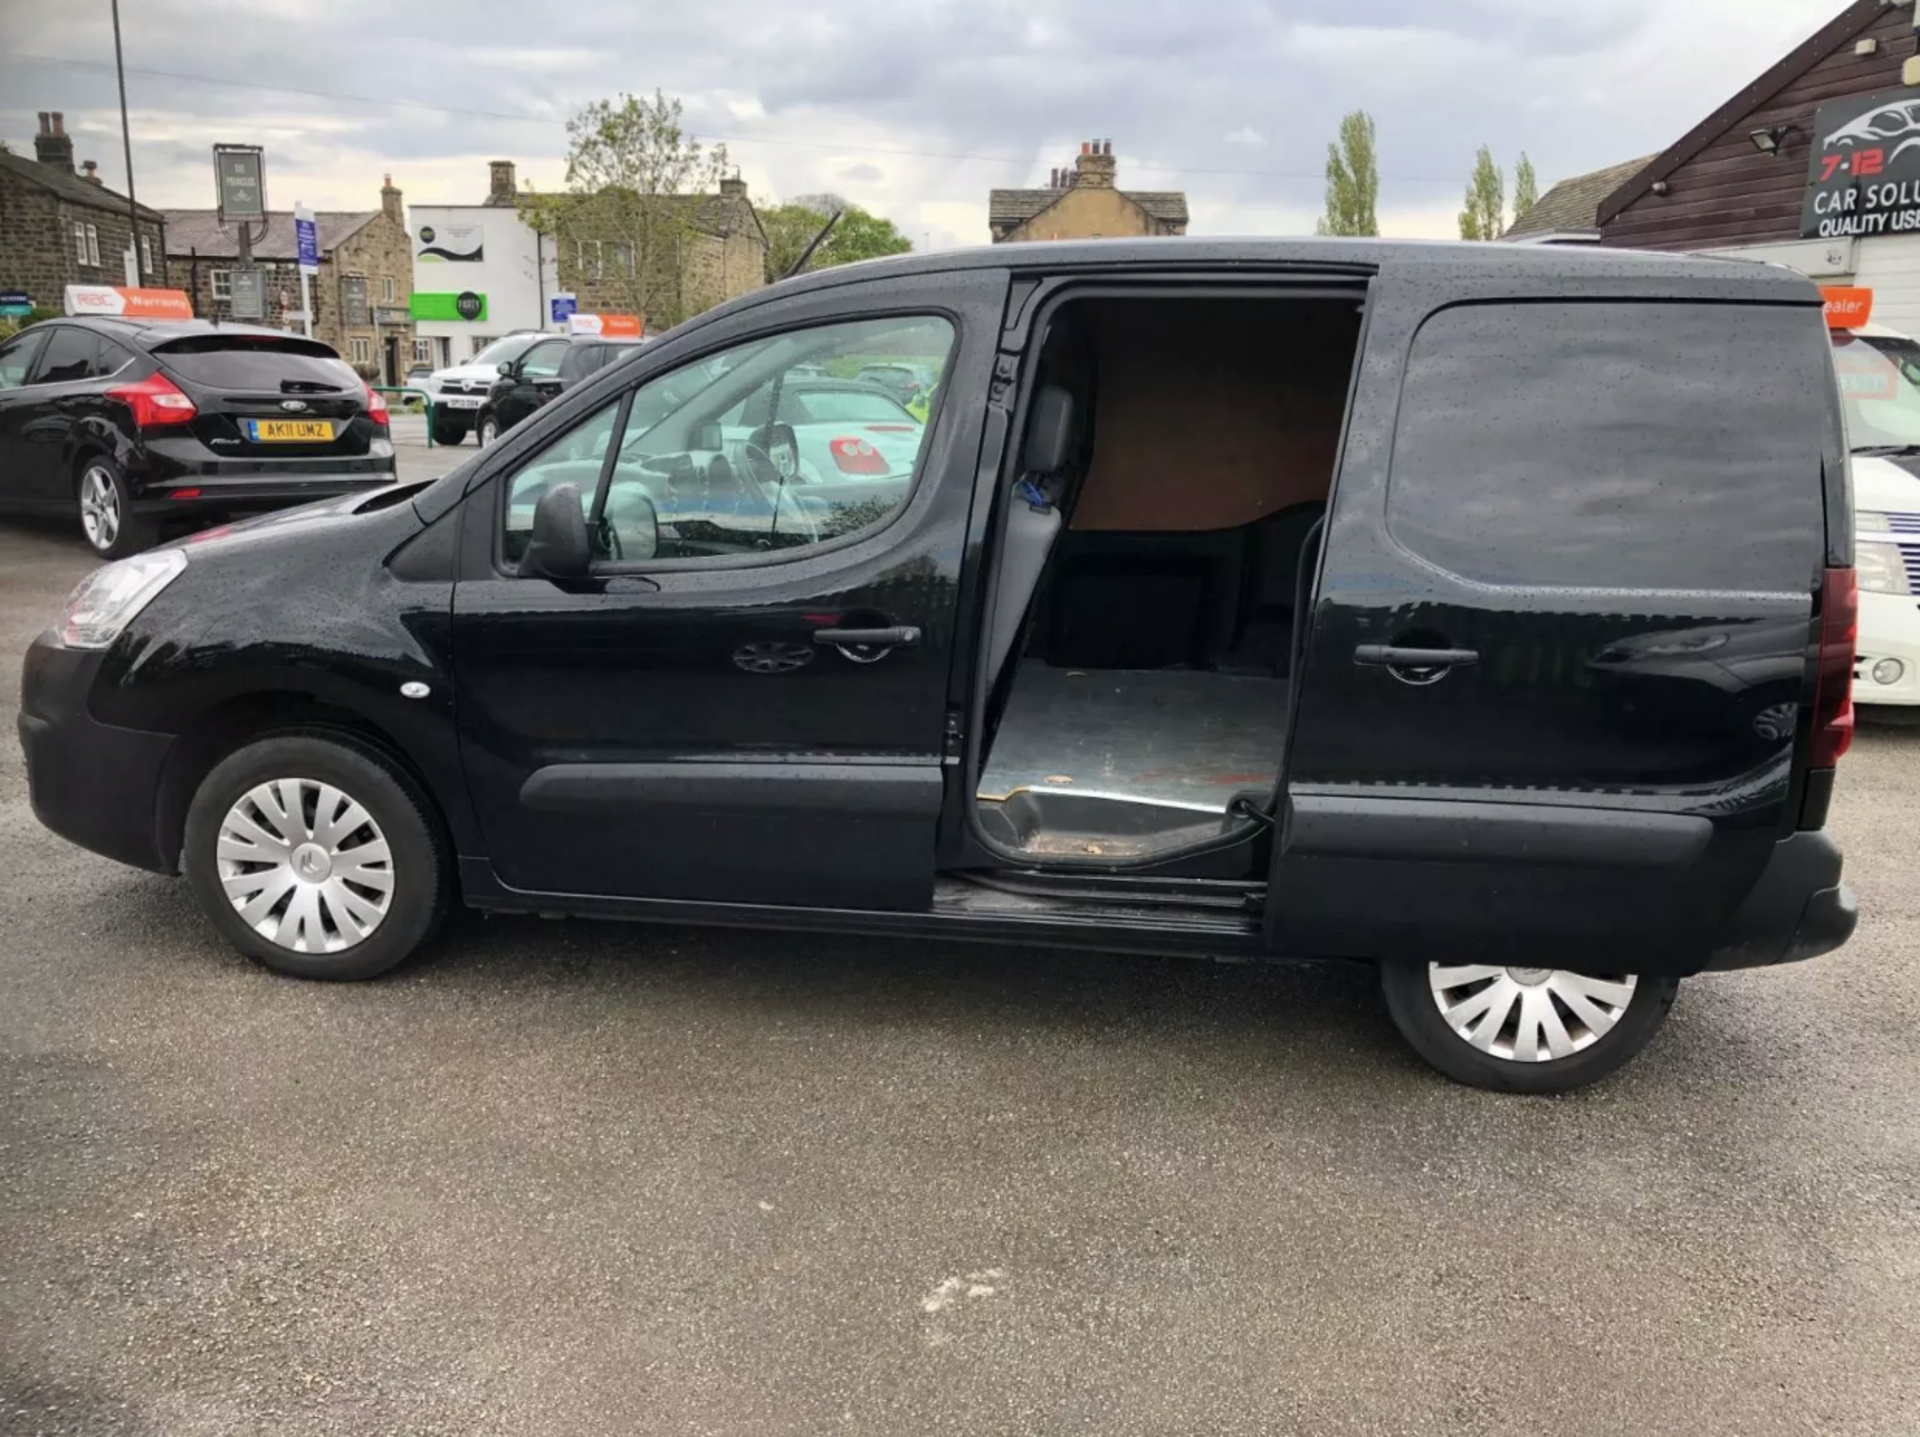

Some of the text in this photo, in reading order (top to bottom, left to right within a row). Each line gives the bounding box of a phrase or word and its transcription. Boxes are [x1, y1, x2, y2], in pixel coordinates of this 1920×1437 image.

[1820, 148, 1883, 181] 7-12
[1814, 188, 1857, 214] CAR
[1819, 212, 1889, 237] QUALITY
[130, 295, 187, 309] Warranty
[267, 422, 325, 437] AK11 UMZ
